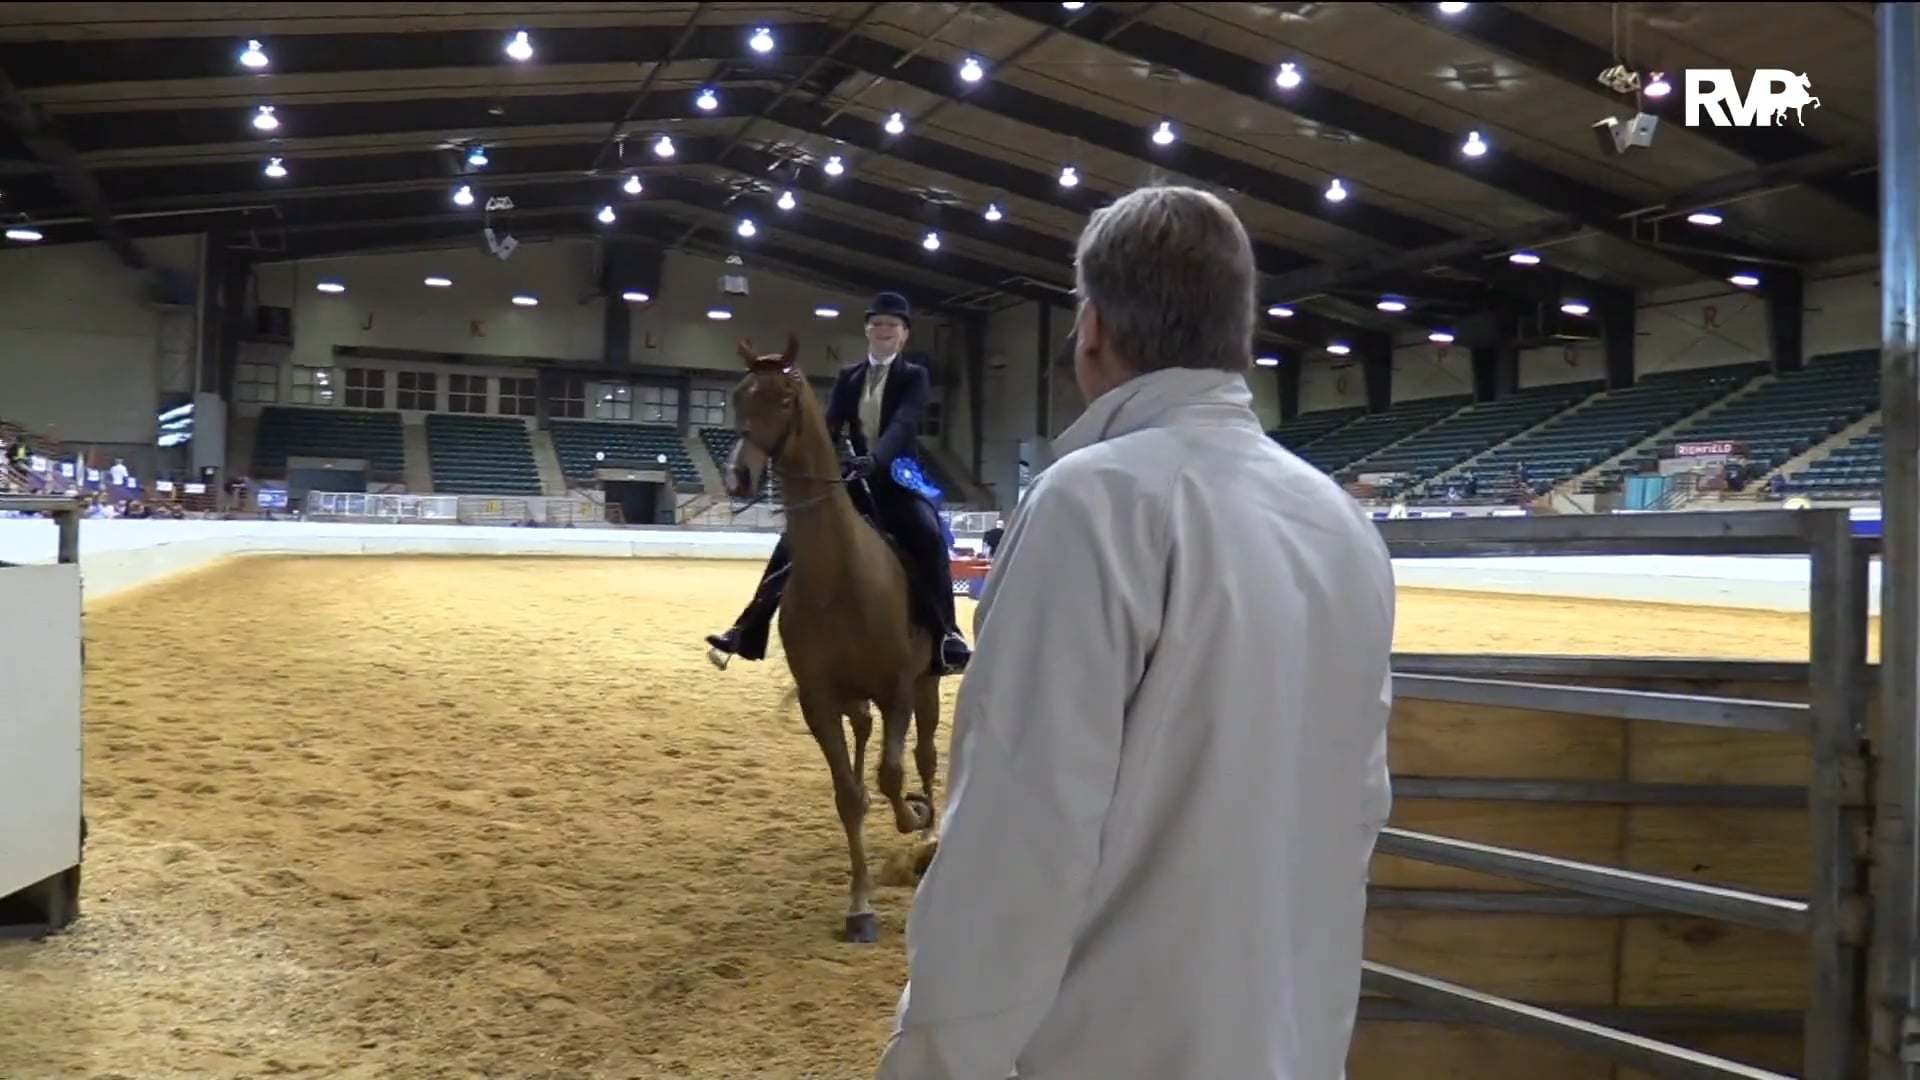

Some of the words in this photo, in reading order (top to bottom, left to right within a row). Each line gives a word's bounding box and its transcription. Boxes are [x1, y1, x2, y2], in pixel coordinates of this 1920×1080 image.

[361, 311, 374, 331] J
[1704, 305, 1720, 328] R
[469, 319, 487, 338] K
[644, 331, 656, 349] L
[825, 345, 841, 361] N
[1678, 443, 1732, 455] RICHFIELD
